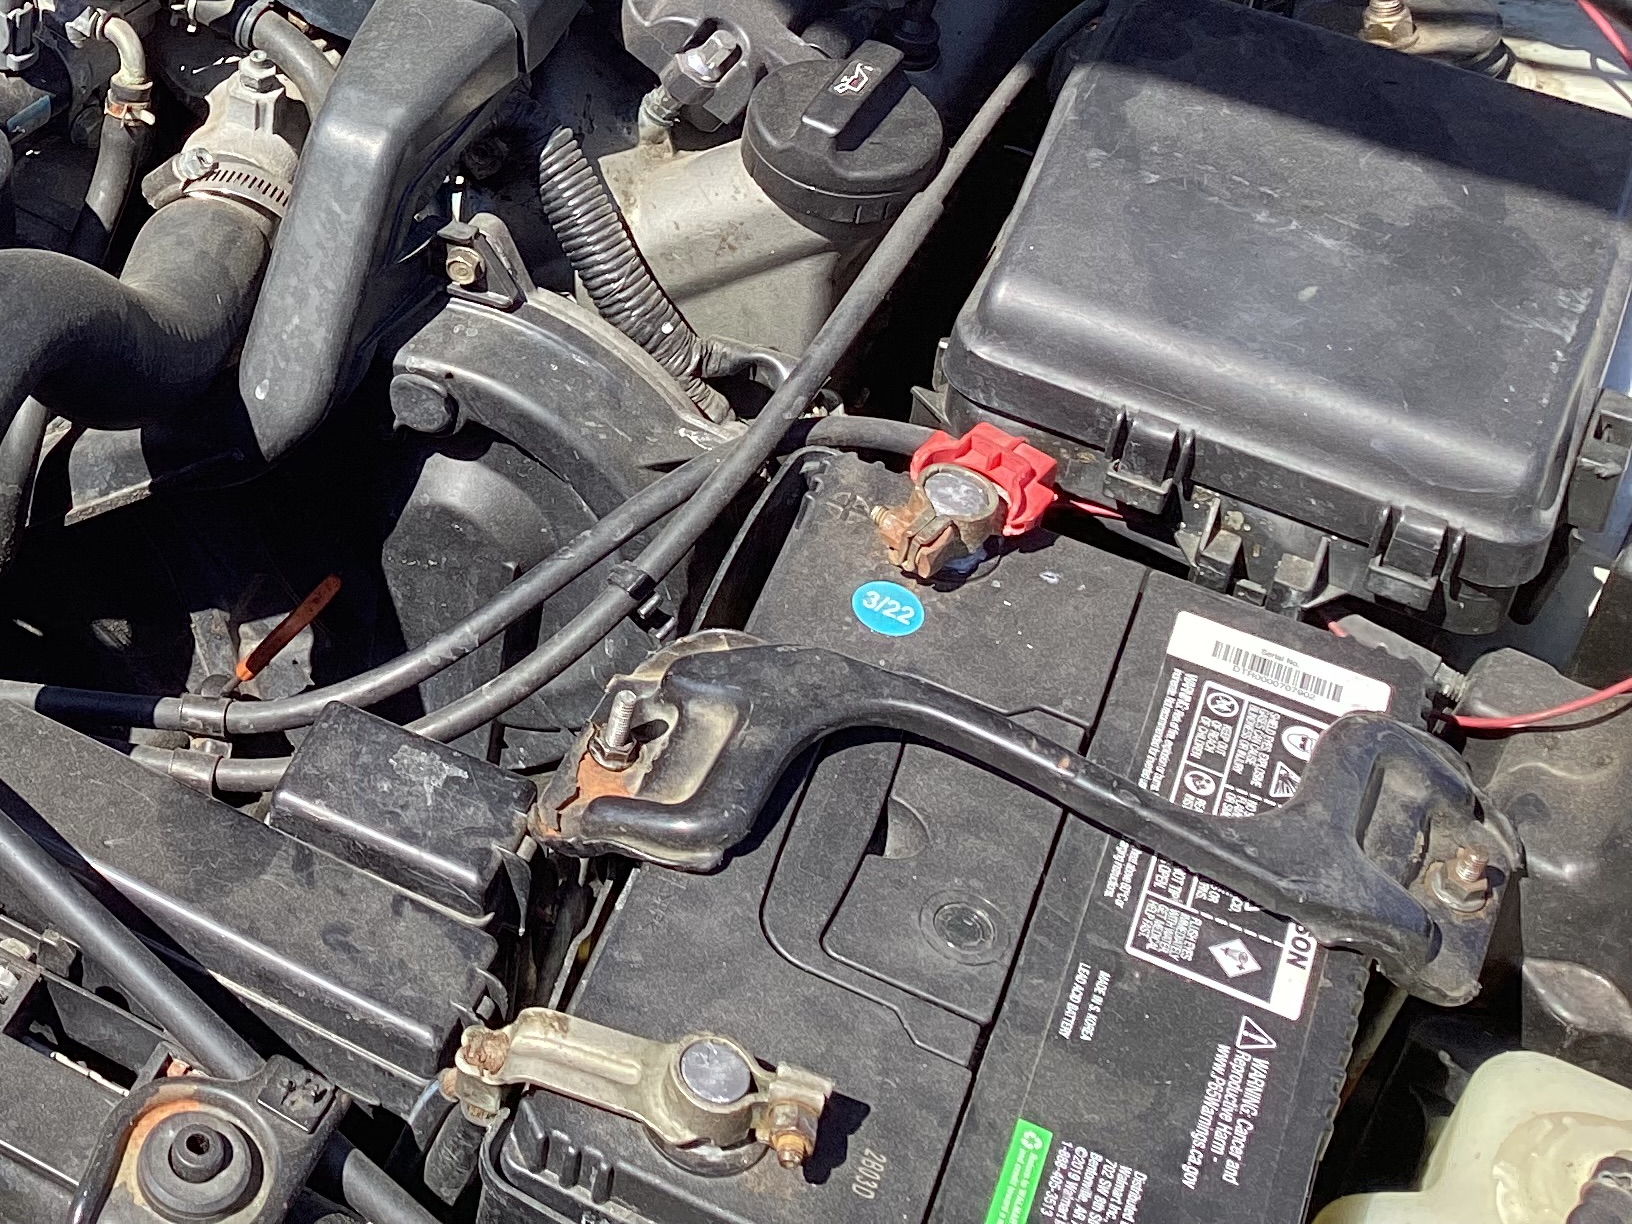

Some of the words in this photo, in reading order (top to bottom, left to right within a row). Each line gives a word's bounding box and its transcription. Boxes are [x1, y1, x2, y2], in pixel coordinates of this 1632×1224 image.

[860, 587, 917, 627] 3/22
[1261, 647, 1283, 661] Serial
[1174, 671, 1197, 712] WARNING:
[1150, 703, 1171, 748] recommended
[1219, 723, 1232, 741] KEEP
[1240, 704, 1259, 740] BLINDNESS
[1255, 707, 1269, 731] GASES
[1264, 711, 1280, 736] SHIELD
[1189, 724, 1208, 759] CHILDREN
[1203, 728, 1219, 753] REACH
[1215, 740, 1227, 756] OUT
[1251, 728, 1263, 744] CAN
[1156, 737, 1174, 767] explosion
[1244, 742, 1260, 766] CAUSE
[1250, 751, 1270, 788] EXPLOSIVE
[1166, 883, 1181, 899] TIP
[1143, 899, 1158, 920] HELP
[1155, 903, 1169, 920] GET
[1165, 908, 1179, 929] WITH
[1145, 918, 1164, 952] MEDICAL
[1168, 912, 1191, 961] IMMEDIATELY
[1185, 916, 1202, 943] FLUSH
[1074, 961, 1091, 985] LEAD
[1093, 969, 1110, 996] MADE
[1068, 982, 1084, 1004] ACID
[1091, 993, 1103, 1005] IN
[1057, 1001, 1078, 1039] BATTERY
[1088, 1002, 1100, 1014] S.
[1079, 1012, 1098, 1042] KOREA
[1218, 1047, 1251, 1124] Reproductive
[1239, 1056, 1269, 1120] WARNING:
[1177, 1042, 1230, 1190] www.P65Warnings.ca.gov
[1209, 1121, 1232, 1156] Harm
[1228, 1116, 1253, 1161] Cancer
[1040, 1139, 1073, 1217] 1-888-405-3513
[1076, 1151, 1102, 1206] Bentonville,
[1101, 1158, 1117, 1179] 702
[1221, 1158, 1241, 1186] and
[1096, 1177, 1112, 1197] SW
[1110, 1163, 1131, 1205] Walmart
[1121, 1170, 1147, 1223] Distributed
[1055, 1179, 1077, 1220] Walmart
[1072, 1203, 1087, 1222] AR
[1091, 1194, 1106, 1213] 8th
